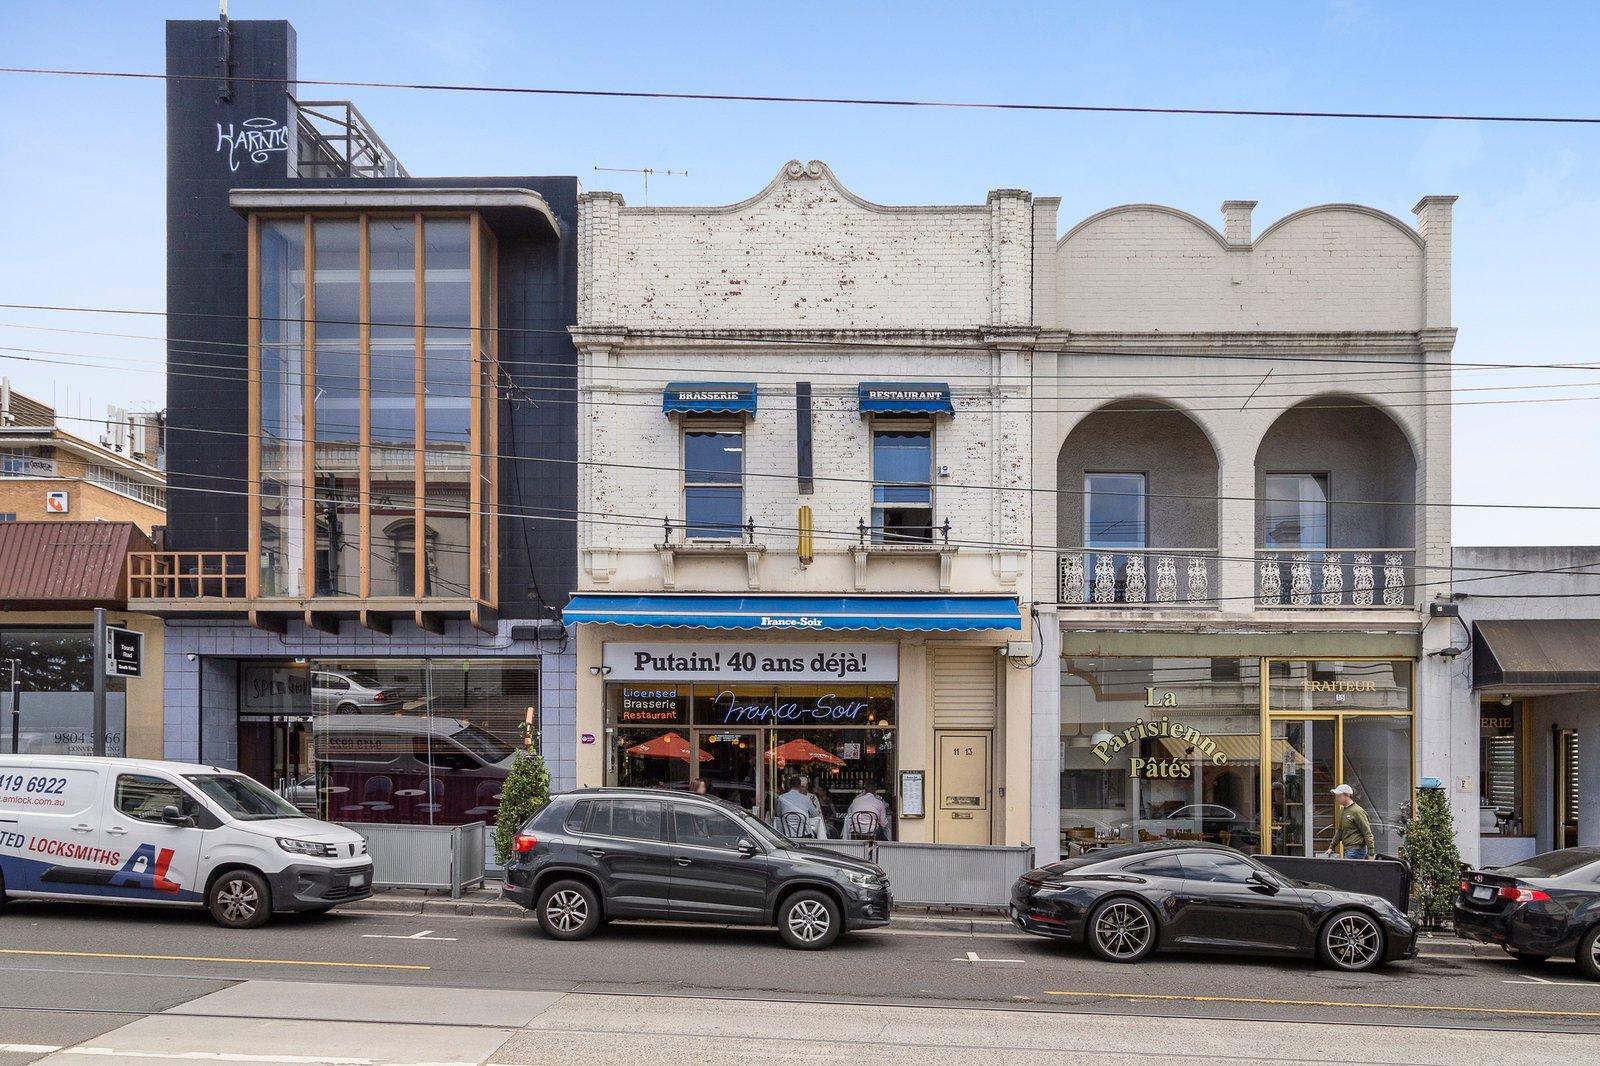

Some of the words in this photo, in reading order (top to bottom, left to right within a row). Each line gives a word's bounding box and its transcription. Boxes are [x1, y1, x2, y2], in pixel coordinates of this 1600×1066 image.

[678, 391, 739, 400] BRASSERIE
[869, 391, 942, 400] RESTAURANT
[761, 617, 822, 626] France-Soir
[634, 651, 720, 672] Putain!
[727, 652, 756, 672] 40
[761, 657, 805, 673] ans
[810, 652, 867, 678] déjà!
[1300, 680, 1376, 692] TRAITEUR
[623, 687, 677, 698] Licensed
[1144, 686, 1178, 708] La
[623, 699, 677, 709] Brasserie
[714, 690, 868, 723] France-Soir
[623, 710, 677, 720] Restaurant
[54, 732, 85, 744] 9804
[1090, 716, 1228, 767] Parisienne
[953, 748, 960, 756] 11
[1128, 756, 1192, 779] Pâtés
[27, 776, 67, 794] 6922
[28, 836, 121, 866] LOCKSMITHS
